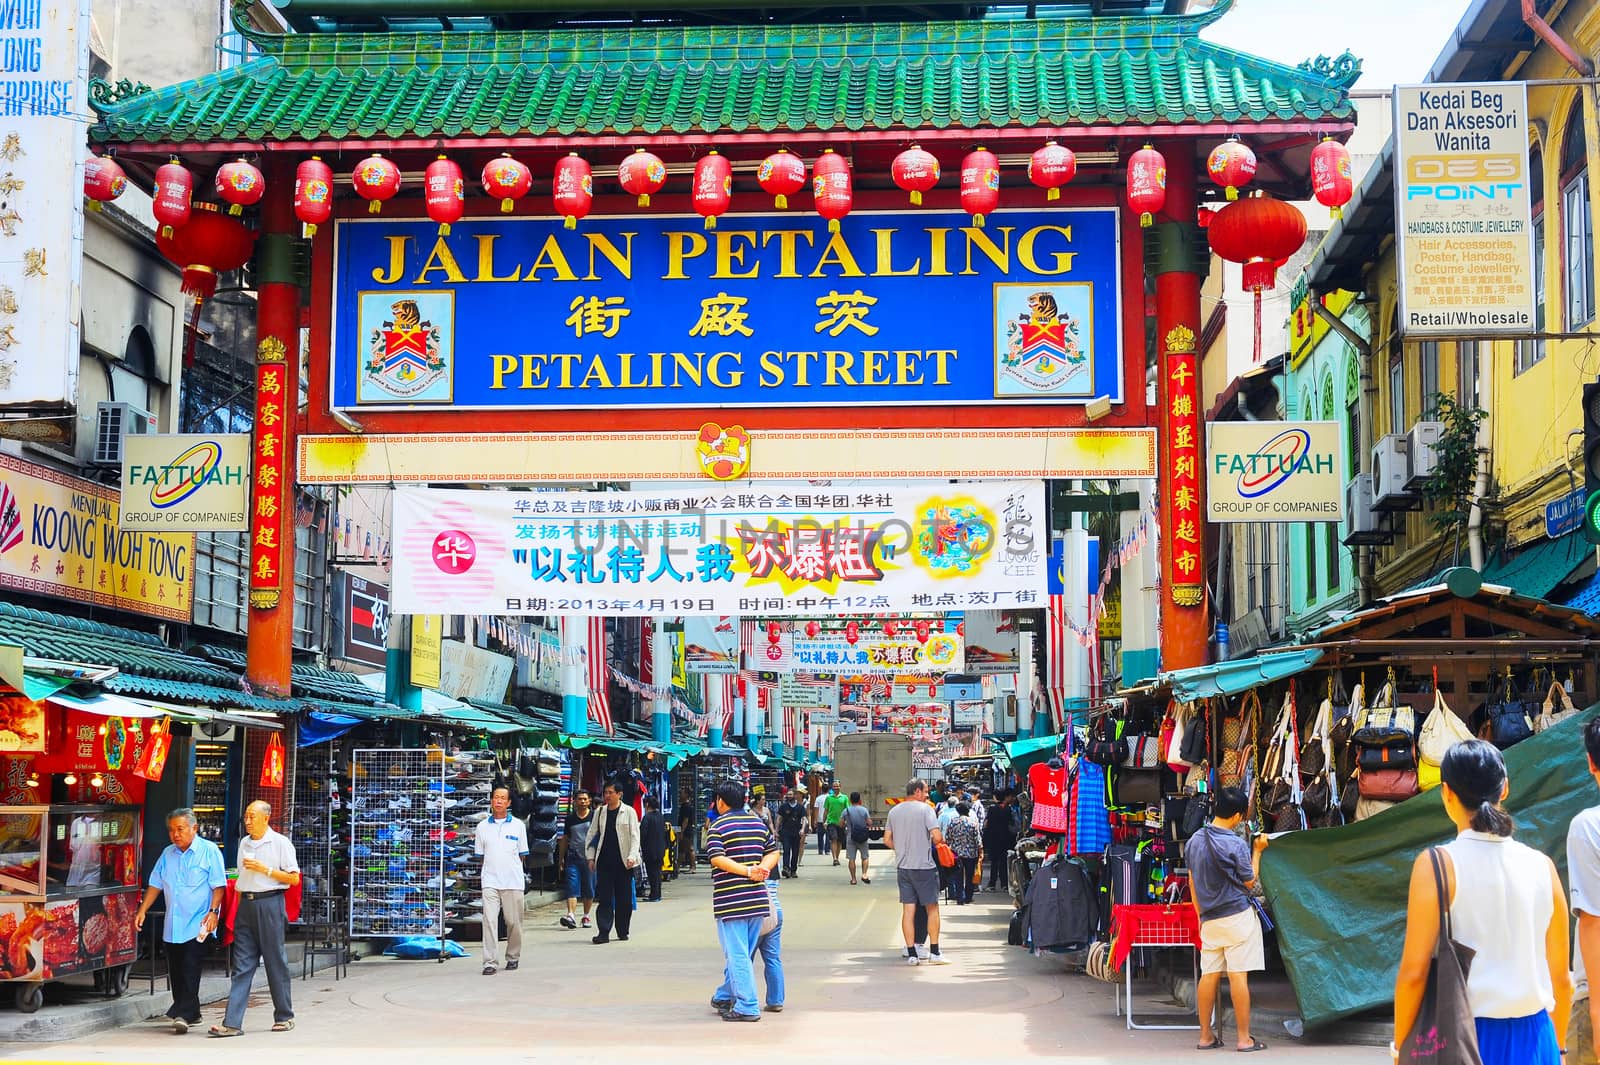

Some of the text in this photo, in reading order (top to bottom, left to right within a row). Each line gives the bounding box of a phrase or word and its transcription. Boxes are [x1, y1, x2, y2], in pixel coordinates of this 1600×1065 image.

[1420, 90, 1503, 112] Kedai Beg
[1408, 110, 1517, 130] Dan Aksesori
[1435, 132, 1490, 151] Wanita
[1414, 158, 1516, 178] DES
[1408, 220, 1523, 234] HANDBAGS & COSTUME JEWELLERY
[372, 224, 1078, 284] JALAN PETALING
[1418, 240, 1440, 250] Hair
[1414, 264, 1465, 274] Costume
[1410, 310, 1529, 326] Retail/Wholesale
[489, 349, 958, 390] PETALING STREET
[1215, 452, 1334, 474] FATTUAH
[129, 464, 242, 486] FATTUAH
[71, 492, 113, 521] MENJUAL
[1213, 501, 1338, 513] GROUP OF COMPANIES
[125, 512, 163, 523] GROUP
[165, 512, 180, 523] OF
[182, 512, 244, 523] COMPANIES
[32, 503, 95, 560] KOONG
[104, 523, 143, 571] WOH
[149, 536, 186, 582] TONG
[438, 536, 473, 568] 华
[739, 595, 891, 611] 时间:中午12点
[912, 590, 1038, 606] 地点:茨厂街
